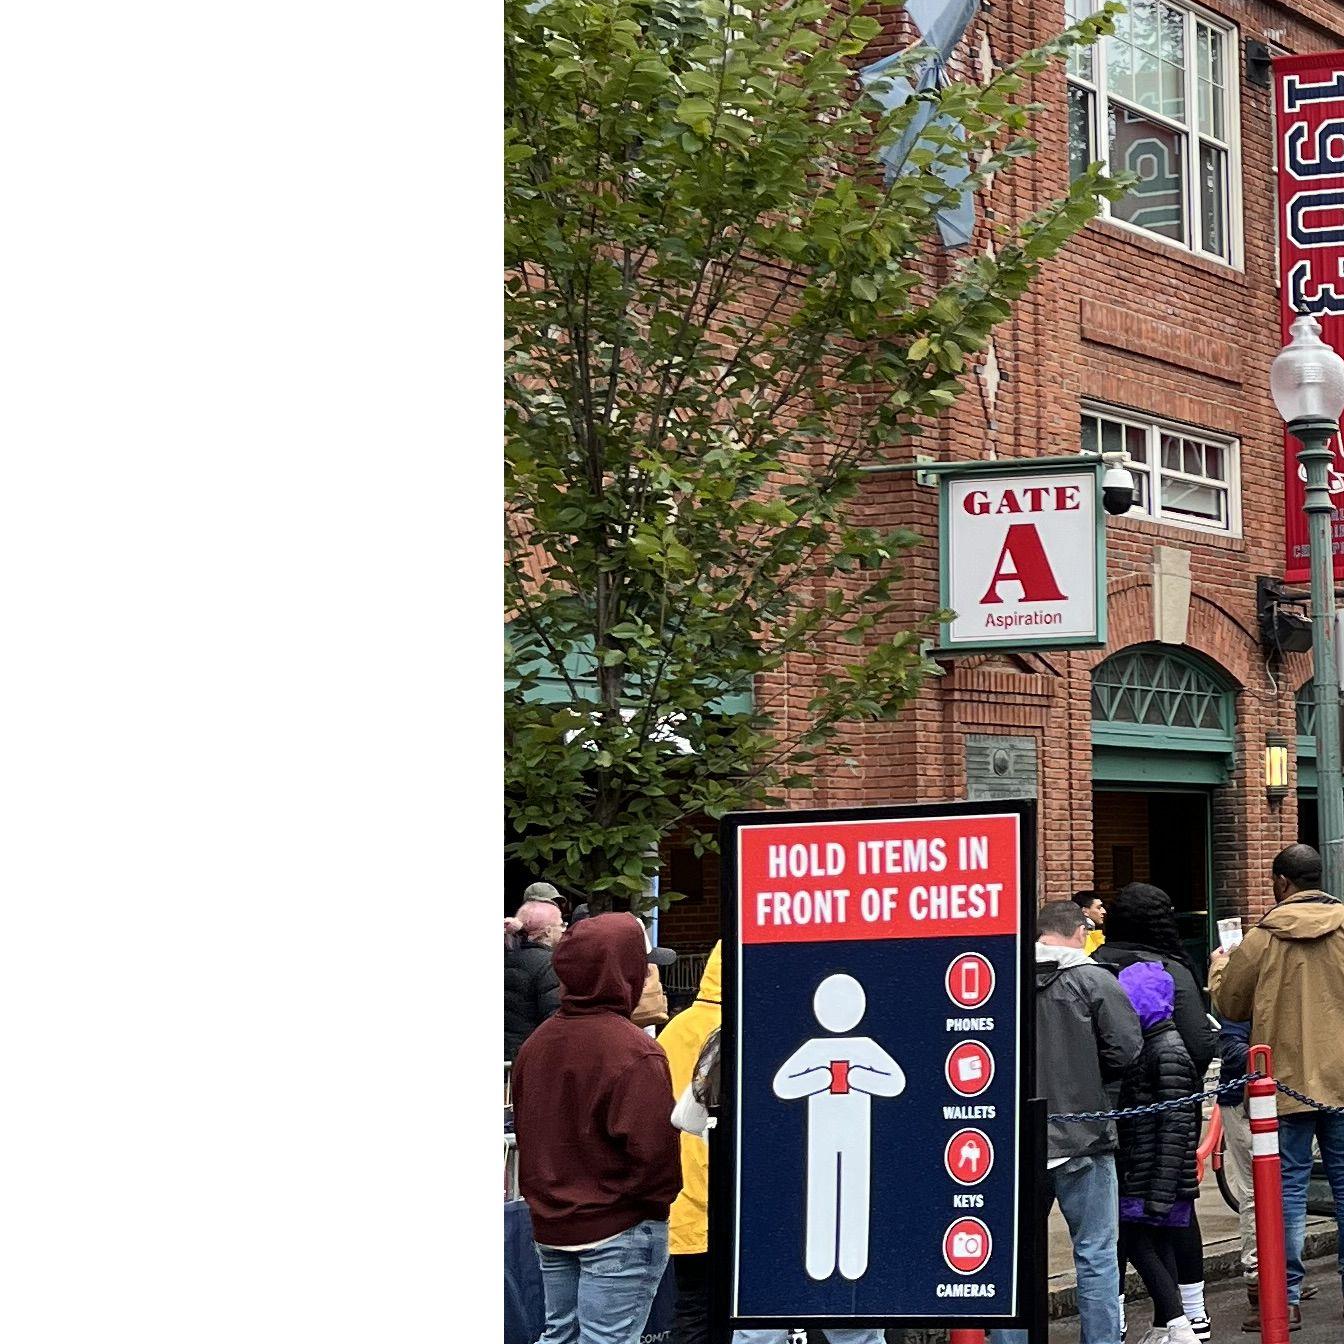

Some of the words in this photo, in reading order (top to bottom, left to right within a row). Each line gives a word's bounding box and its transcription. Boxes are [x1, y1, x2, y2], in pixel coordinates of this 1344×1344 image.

[963, 485, 1081, 516] GATE
[979, 523, 1069, 605] A
[985, 609, 1062, 629] Aspiration
[768, 843, 845, 879] HOLD
[858, 836, 946, 875] ITEMS
[958, 836, 989, 870] IN
[756, 889, 851, 926] FRONT
[860, 887, 897, 922] OF
[908, 883, 1003, 920] CHEST
[945, 1017, 994, 1032] PHONES
[942, 1105, 996, 1120] WALLETS
[952, 1194, 984, 1208] KEYS
[936, 1283, 996, 1298] CAMERAS
